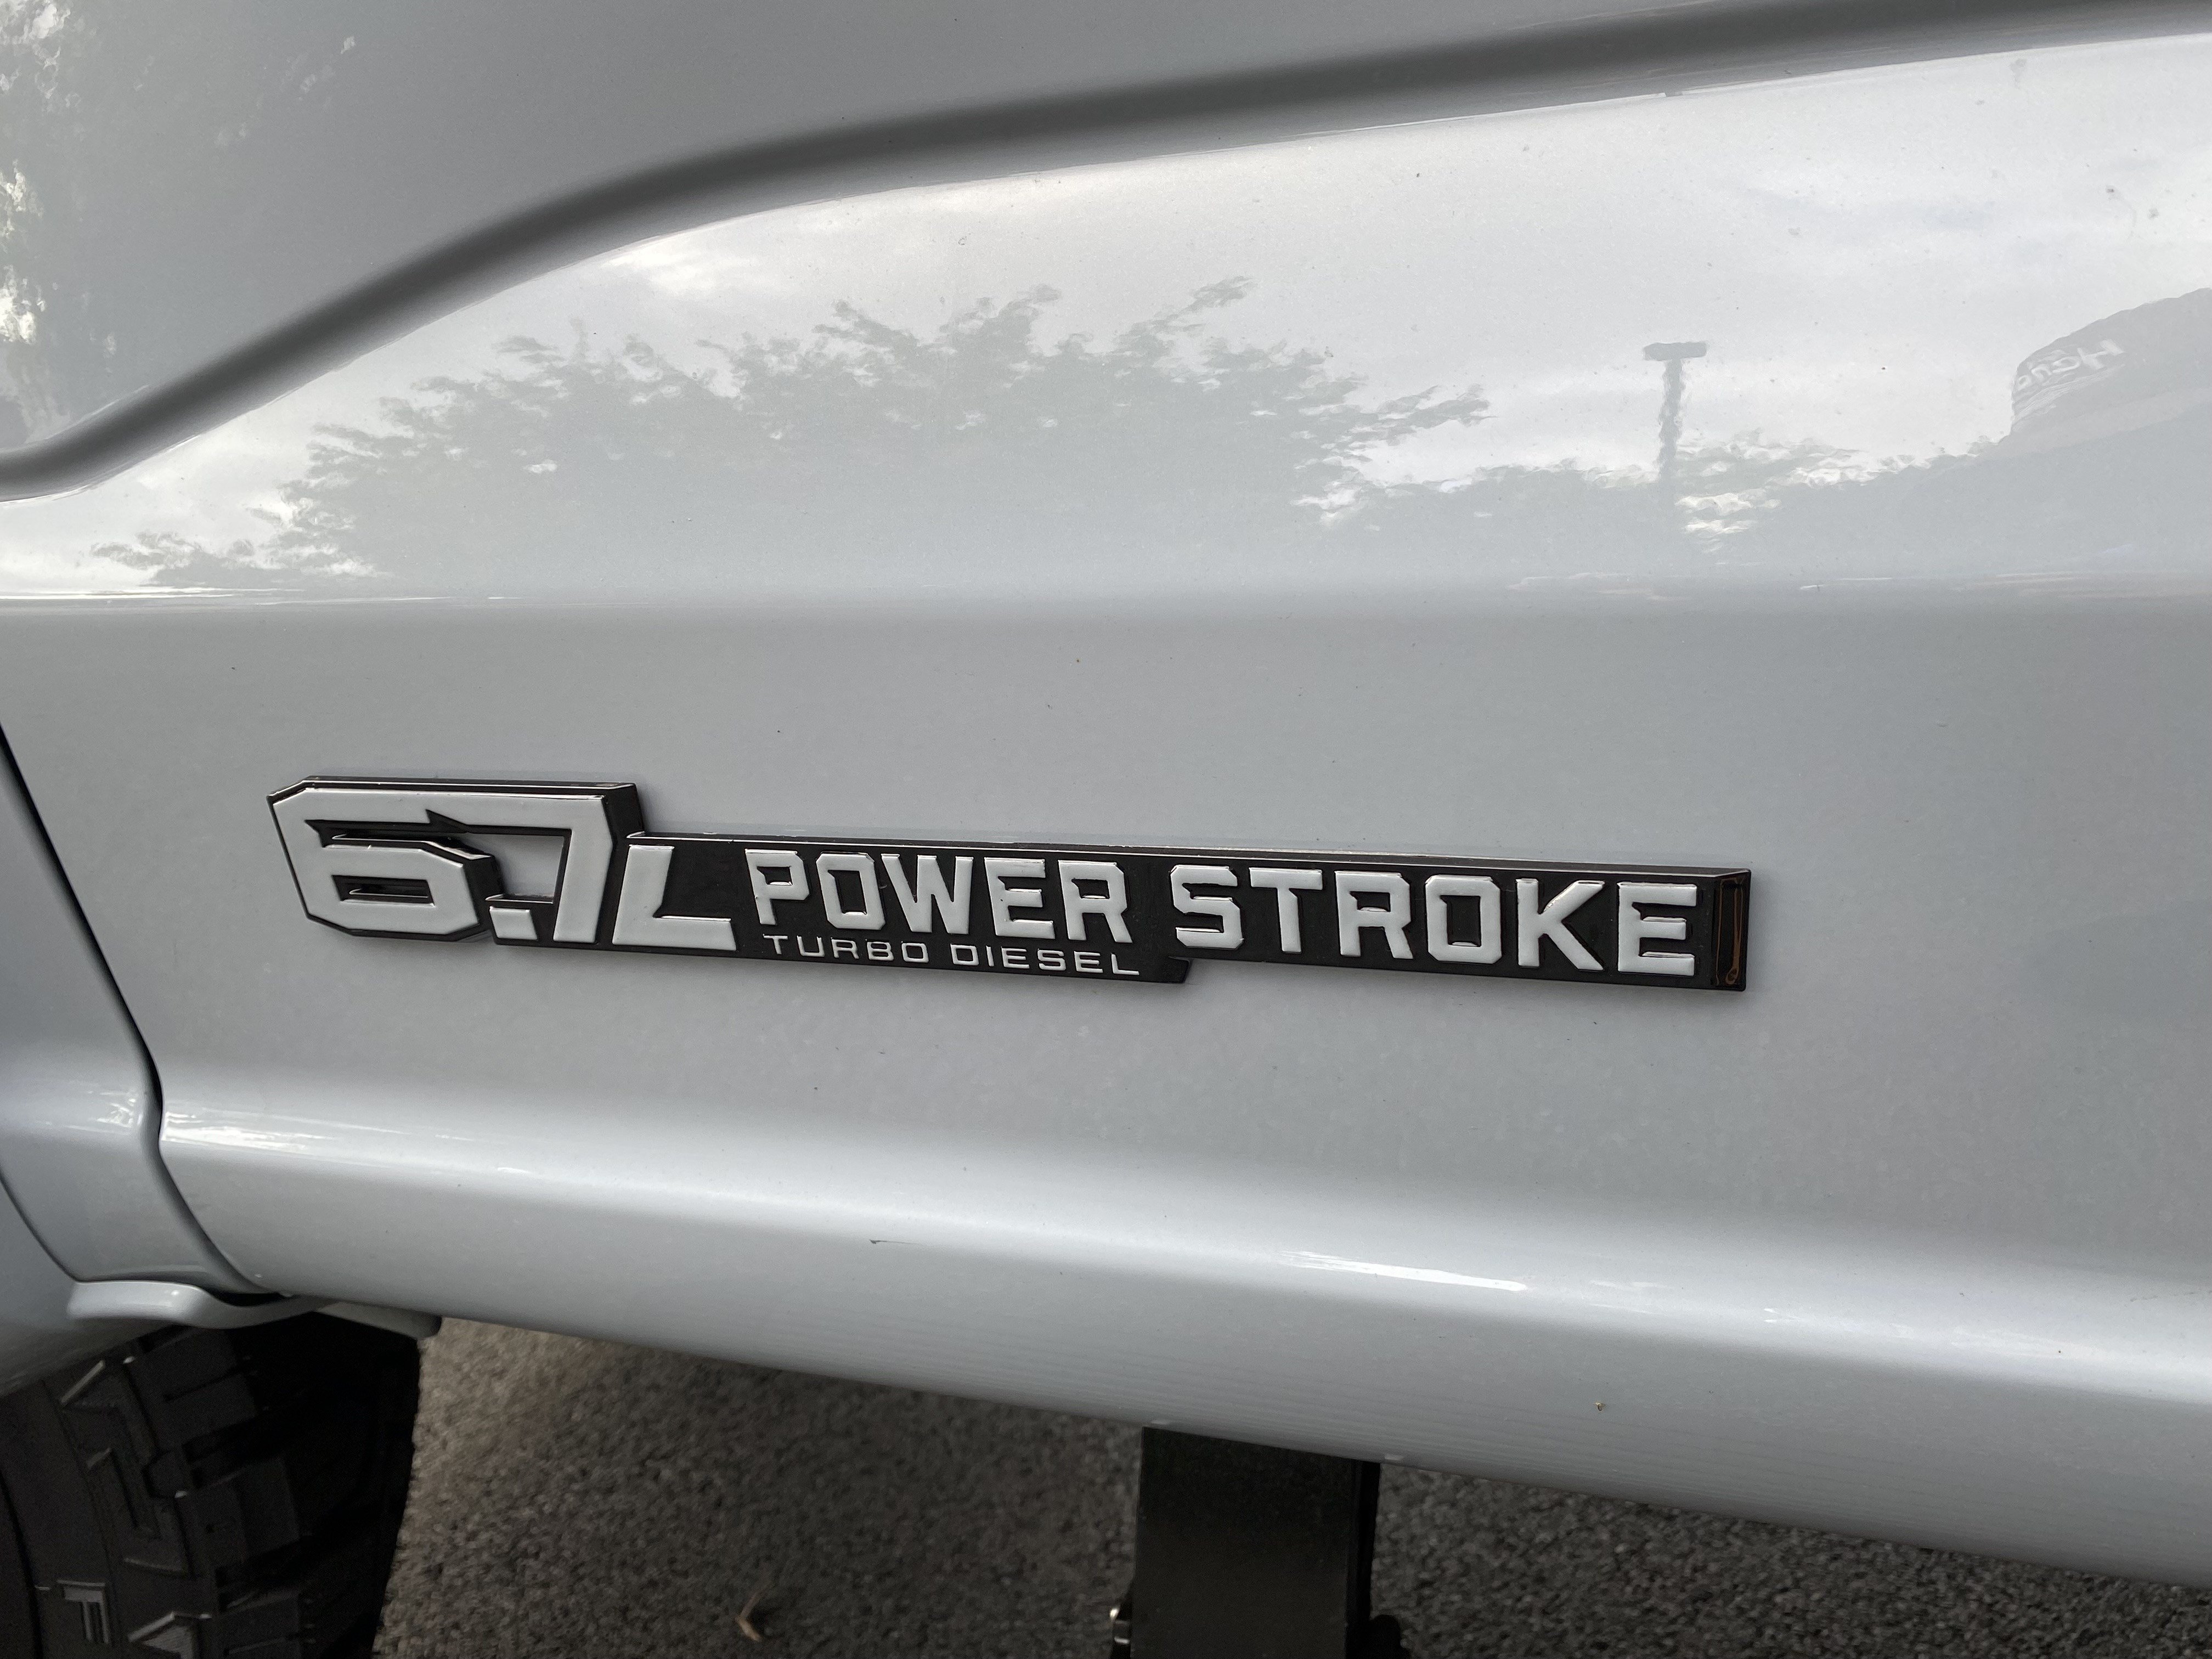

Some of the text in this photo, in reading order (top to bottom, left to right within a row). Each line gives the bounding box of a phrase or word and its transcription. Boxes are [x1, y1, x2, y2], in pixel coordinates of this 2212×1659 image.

[272, 787, 1697, 977] 6.7L POWER STROKE
[763, 934, 1140, 976] TURBO DIESEL
